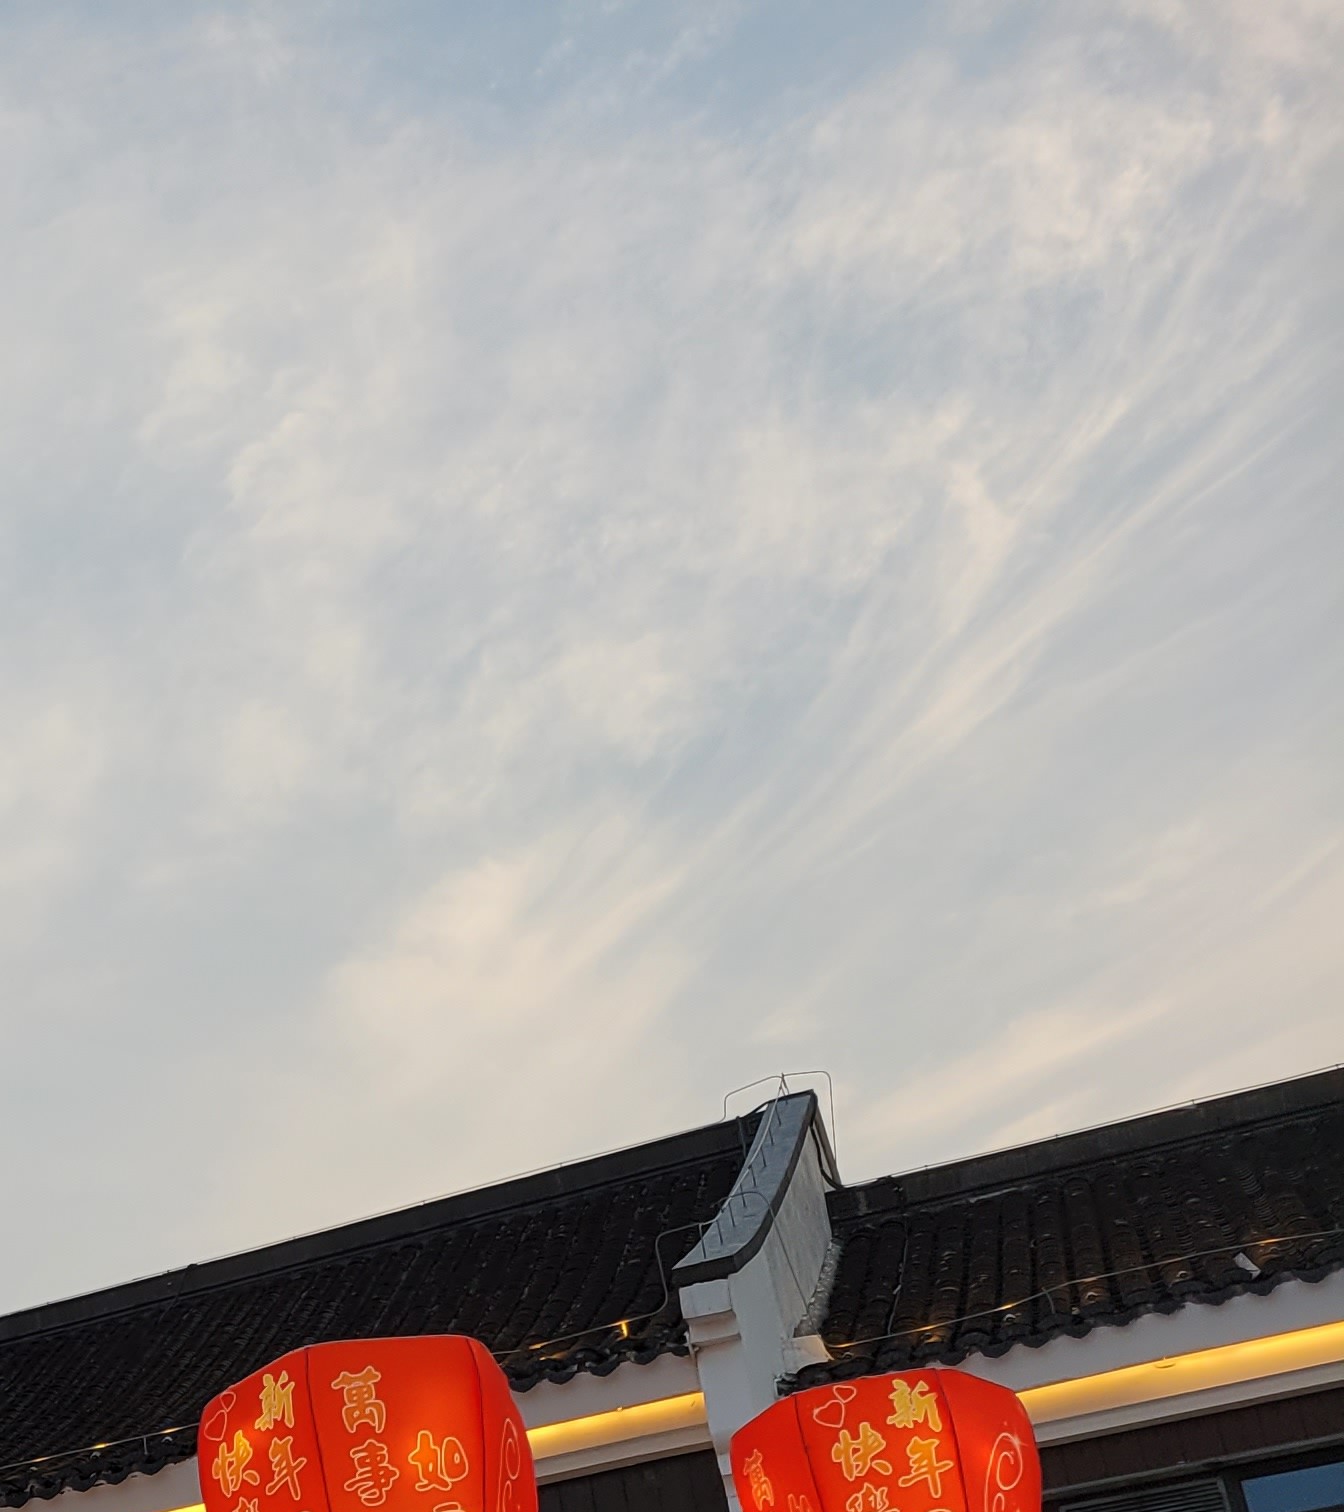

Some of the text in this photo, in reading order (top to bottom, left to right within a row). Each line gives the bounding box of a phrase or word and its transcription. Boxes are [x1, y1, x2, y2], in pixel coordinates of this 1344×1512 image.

[255, 1370, 307, 1500] 新年
[331, 1365, 400, 1507] 萬事
[886, 1379, 954, 1498] 新年
